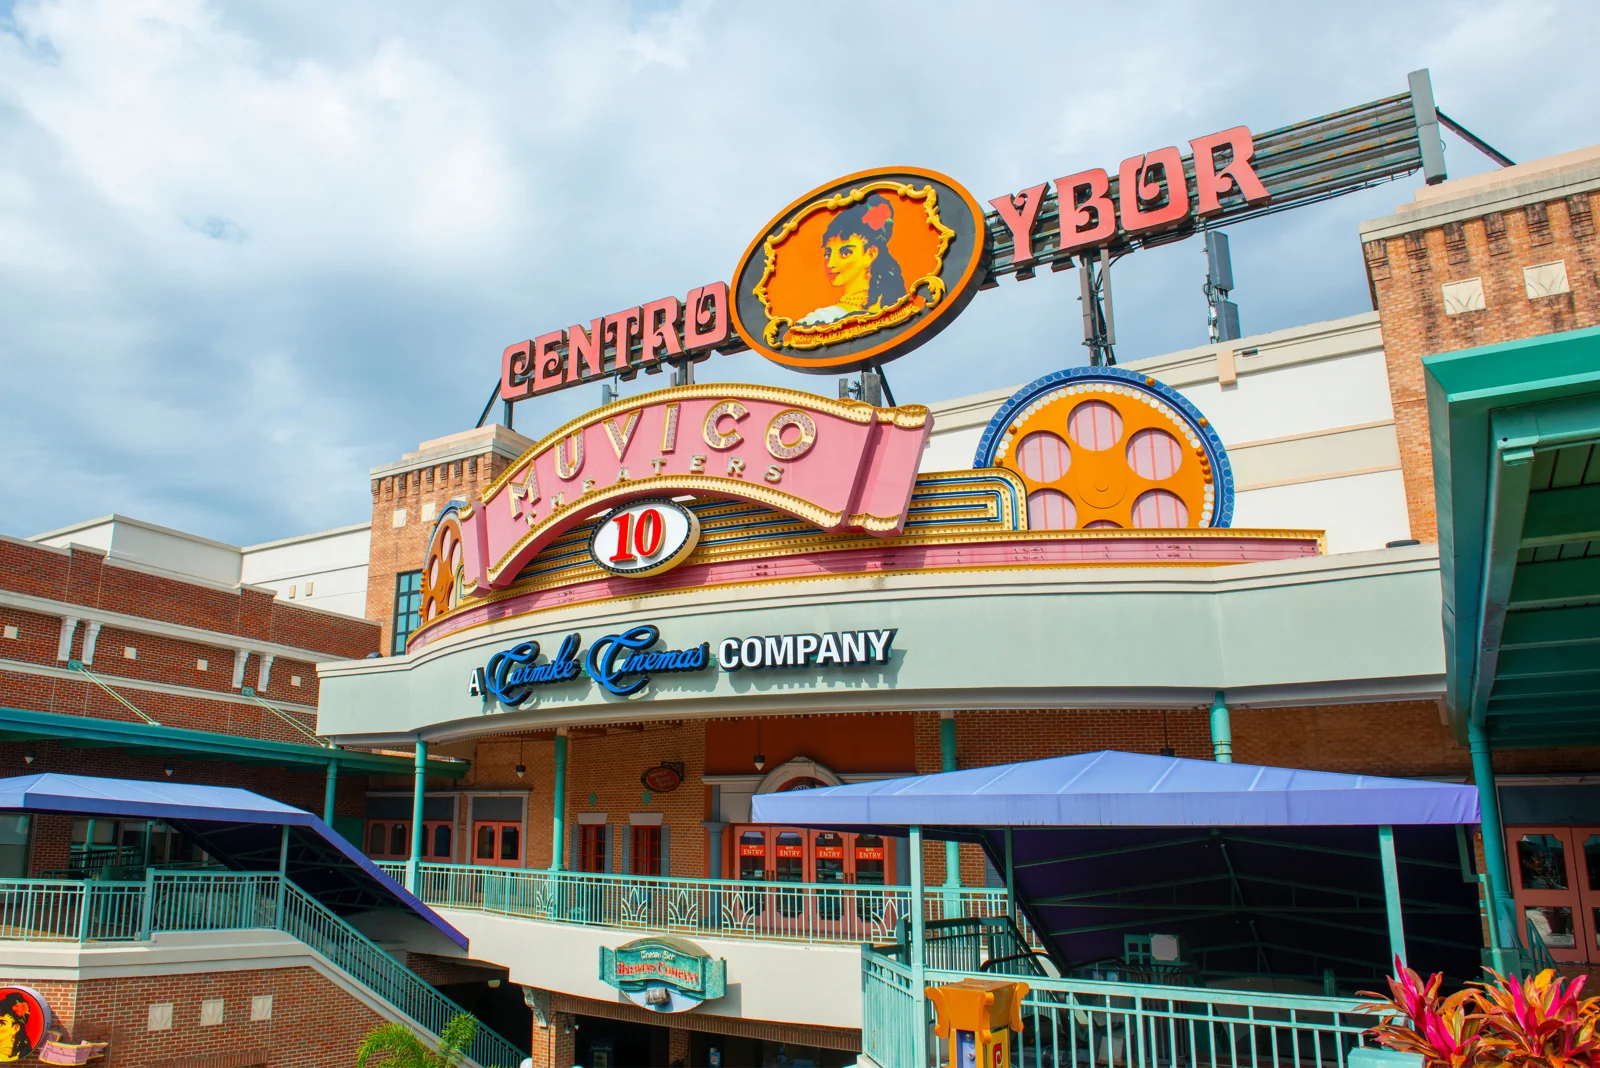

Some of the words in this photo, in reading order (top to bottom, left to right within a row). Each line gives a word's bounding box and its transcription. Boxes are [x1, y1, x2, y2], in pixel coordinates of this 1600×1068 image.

[500, 281, 729, 400] CENTRO
[988, 125, 1271, 264] YBOR
[508, 398, 818, 520] MUVICO
[523, 454, 786, 528] THEATERS
[609, 508, 666, 563] 10
[467, 667, 484, 695] A
[486, 632, 582, 706] Carmike
[586, 624, 710, 697] Cinemas
[718, 628, 898, 671] COMPANY
[743, 848, 764, 856] ENTRY
